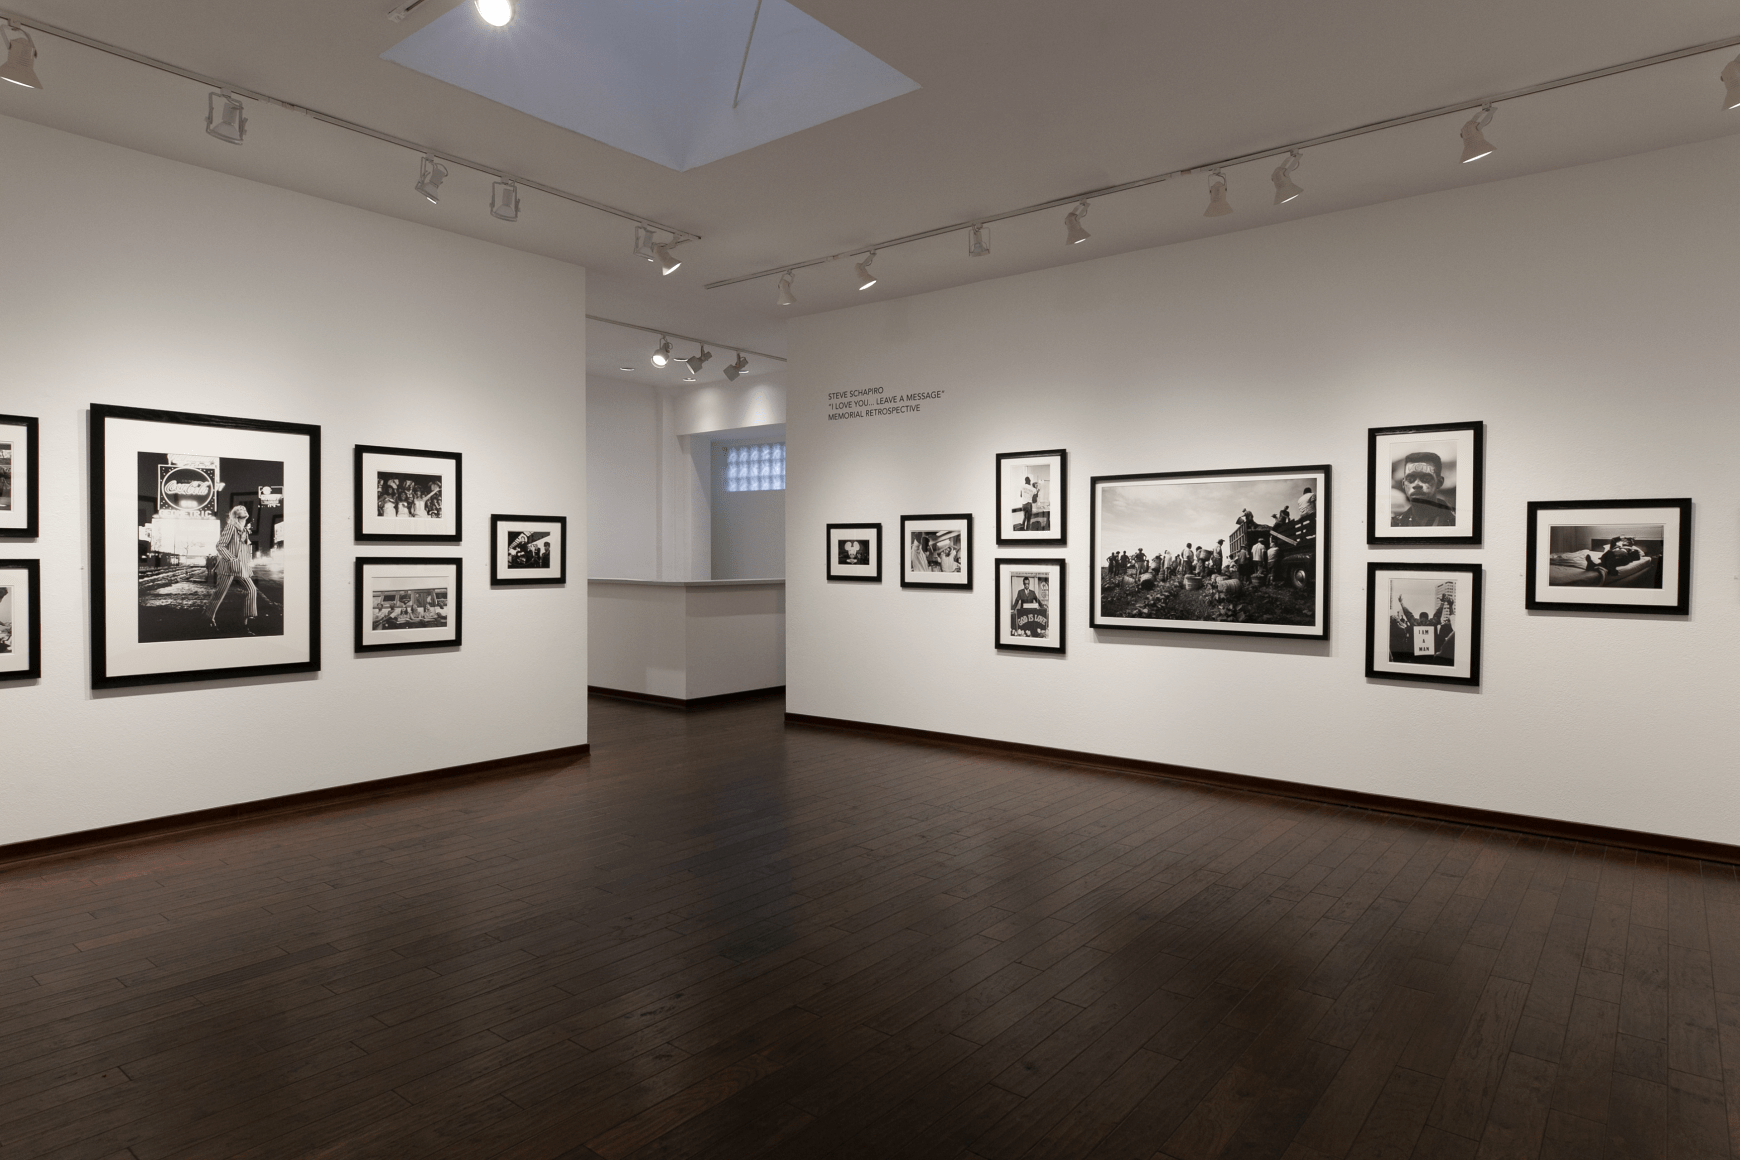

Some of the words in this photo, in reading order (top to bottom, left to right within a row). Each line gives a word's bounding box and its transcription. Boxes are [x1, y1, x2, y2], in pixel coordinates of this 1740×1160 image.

[828, 391, 848, 400] STEVE
[849, 387, 884, 398] SCHAPIRO
[835, 401, 853, 410] LOVE
[876, 396, 898, 405] LEAVE
[828, 410, 864, 421] MEMORIAL
[865, 404, 921, 417] RETROSPECTIVE
[1018, 615, 1028, 626] GOD
[1034, 614, 1047, 626] LOVE
